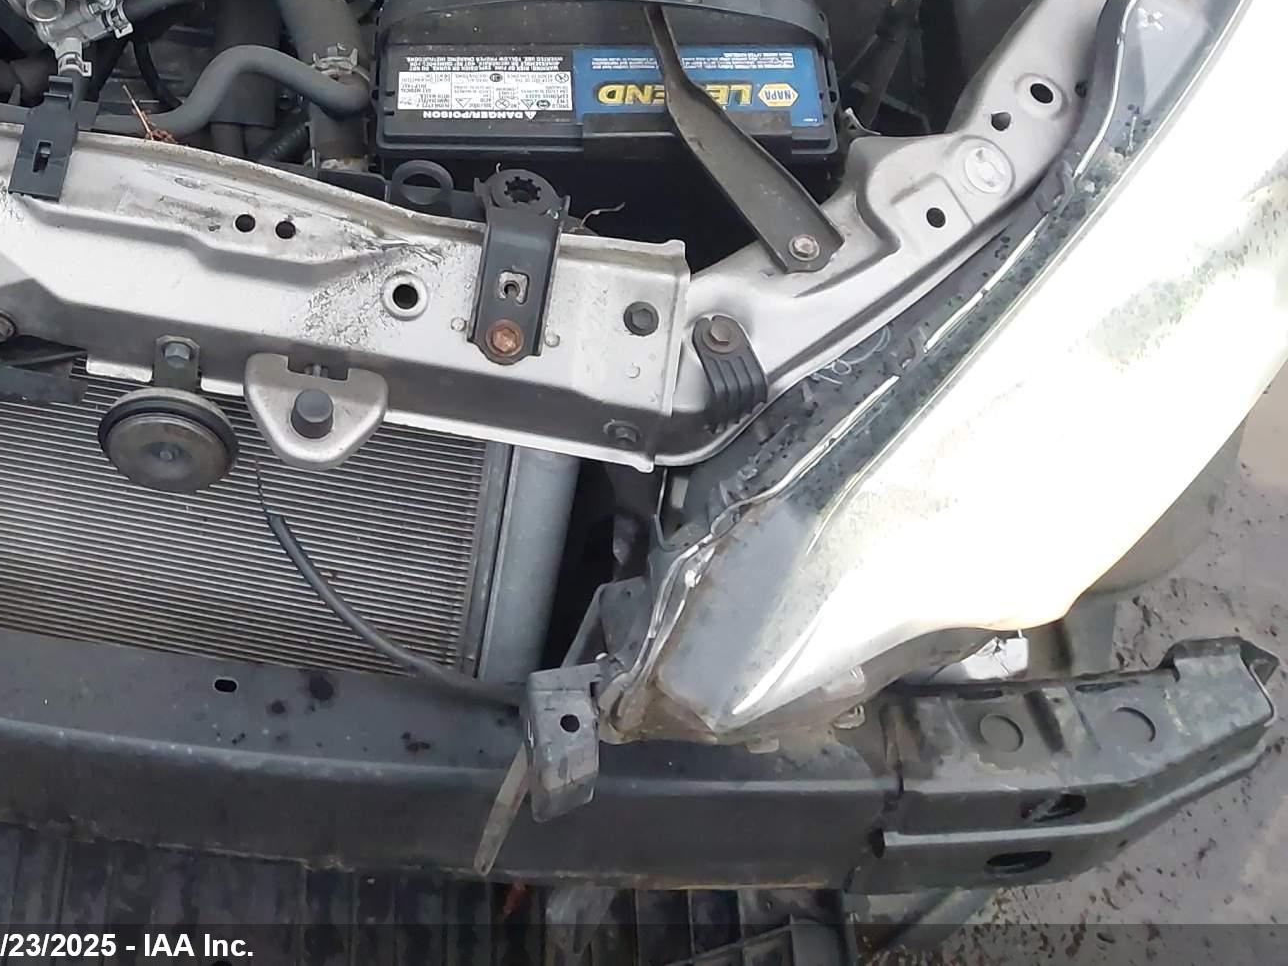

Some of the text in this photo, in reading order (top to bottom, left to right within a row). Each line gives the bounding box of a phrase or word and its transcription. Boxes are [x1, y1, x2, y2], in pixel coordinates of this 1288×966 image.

[597, 83, 753, 106] LEEND
[764, 89, 792, 101] NAPA
[423, 110, 524, 119] DANGER/POISON
